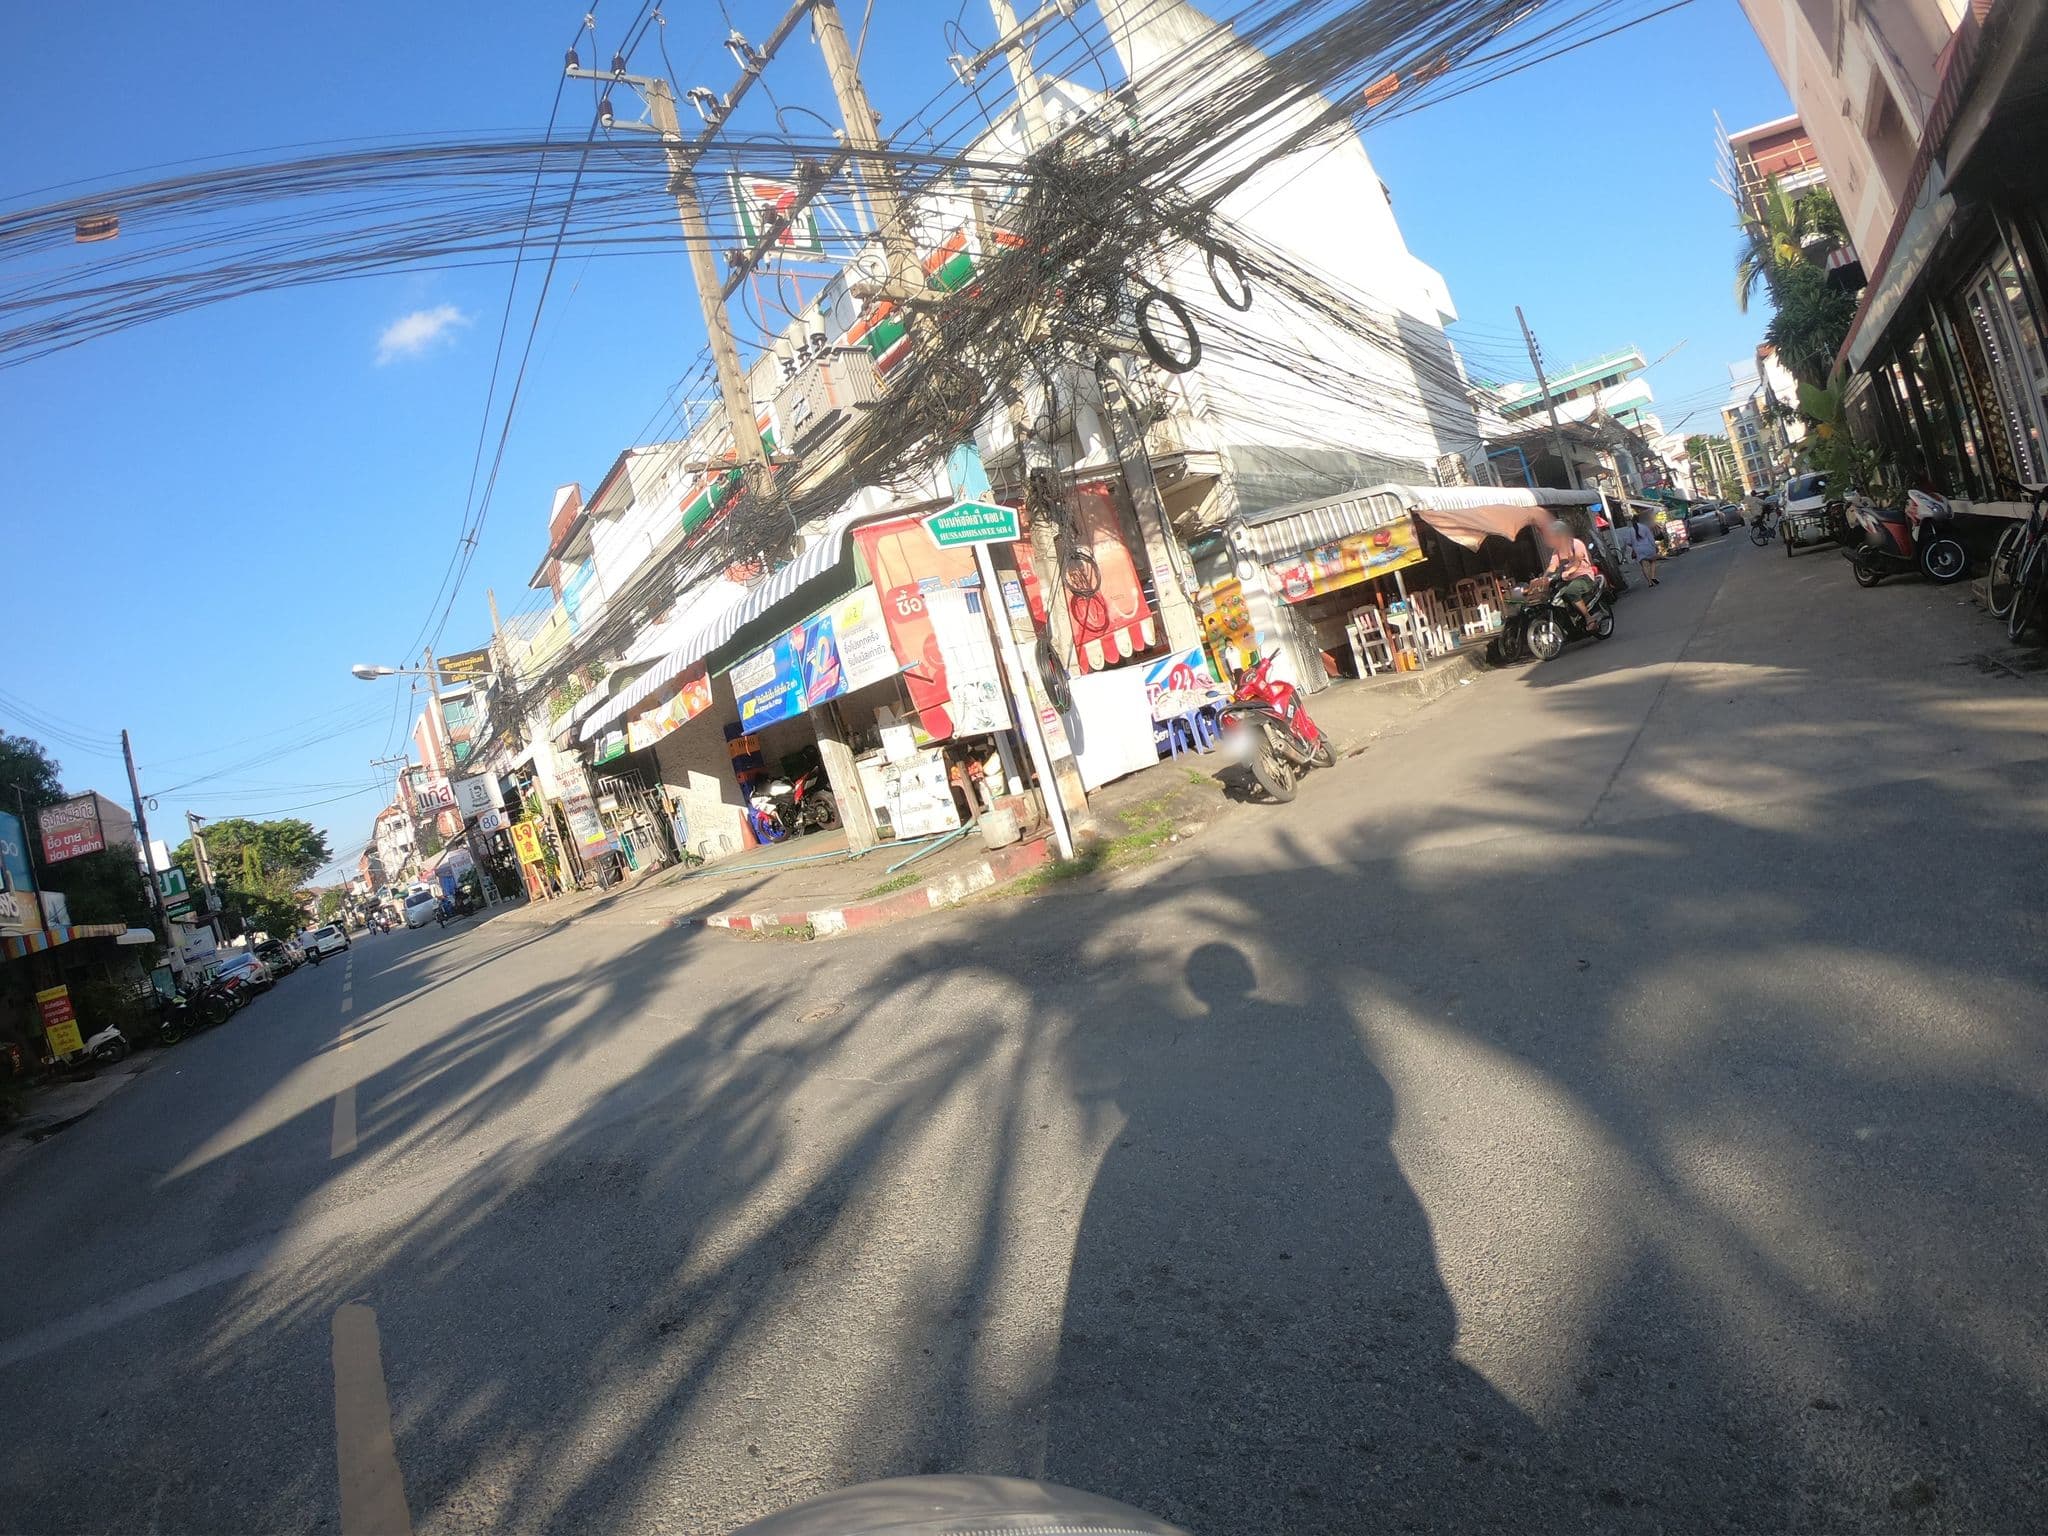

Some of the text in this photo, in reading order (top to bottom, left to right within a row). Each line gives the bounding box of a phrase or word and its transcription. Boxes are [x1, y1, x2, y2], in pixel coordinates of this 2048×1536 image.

[999, 512, 1005, 523] 4
[995, 527, 1007, 536] SOI
[482, 814, 499, 829] 80
